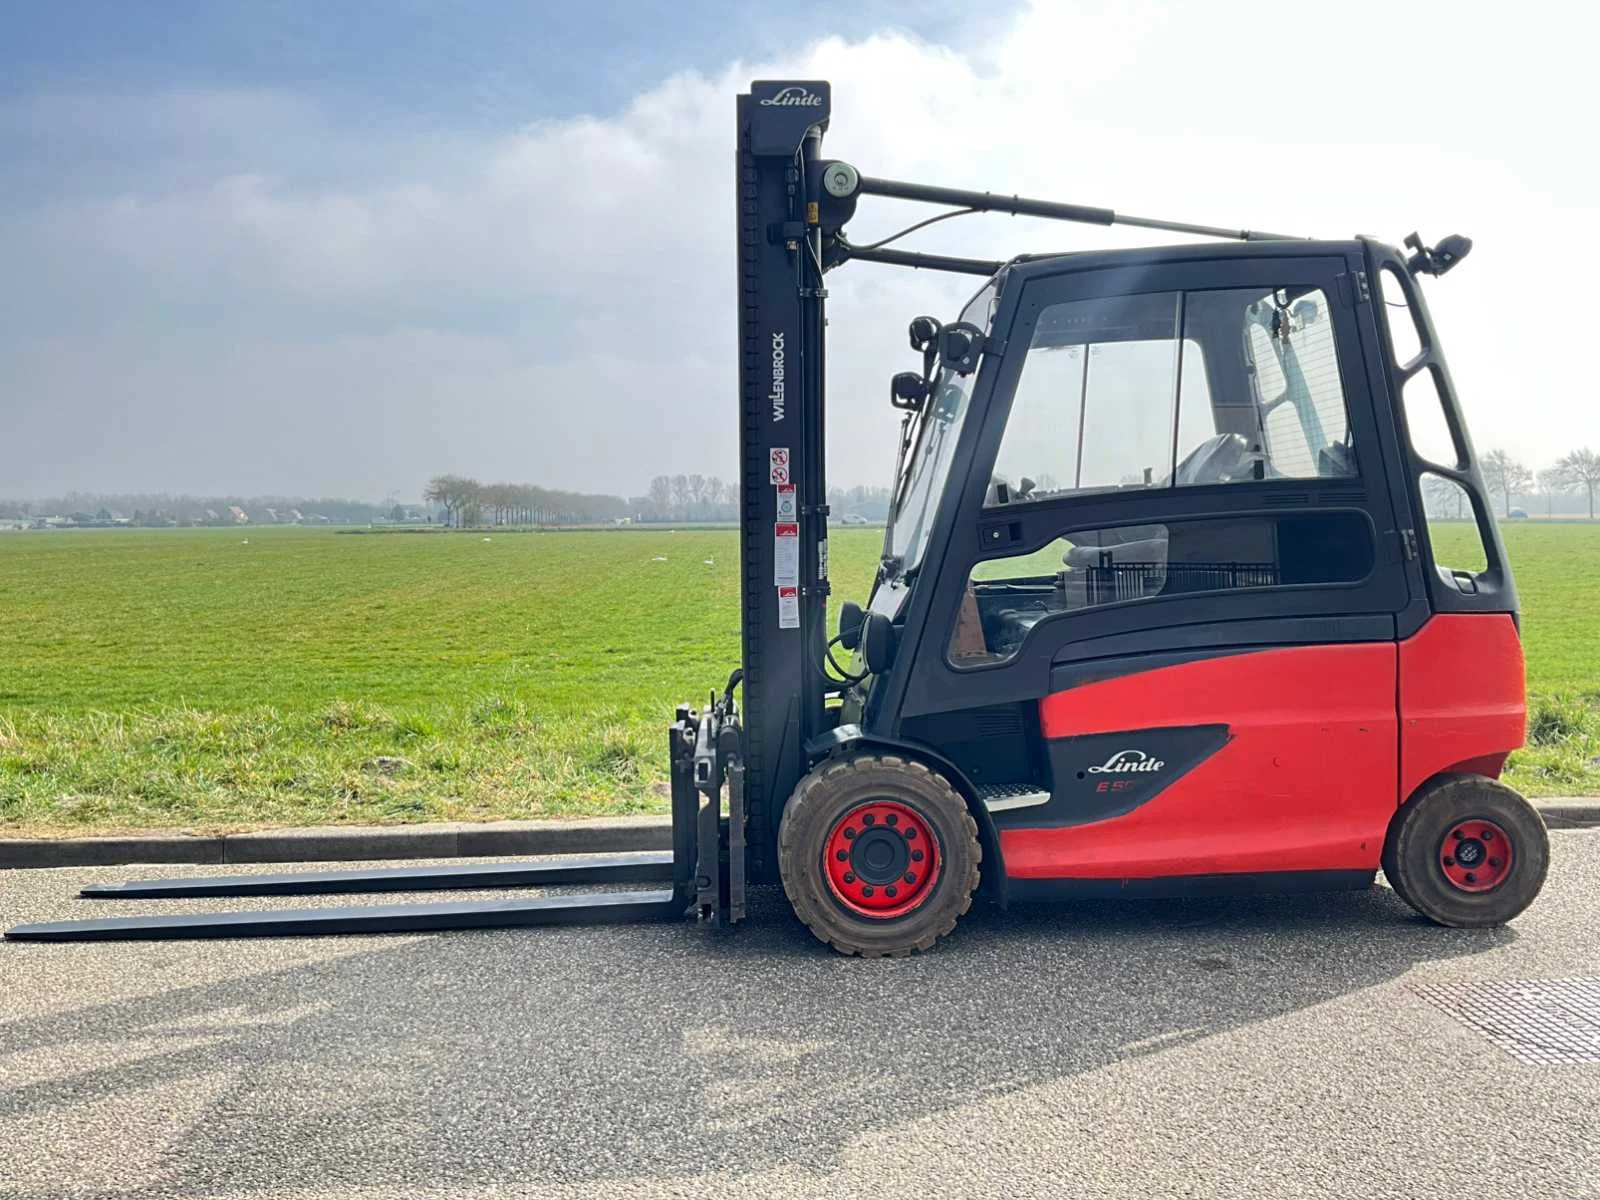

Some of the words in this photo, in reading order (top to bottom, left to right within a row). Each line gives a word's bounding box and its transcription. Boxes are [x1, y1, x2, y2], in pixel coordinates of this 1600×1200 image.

[760, 86, 822, 106] Linde
[768, 332, 784, 422] WILLENBROCK
[1088, 750, 1165, 773] Linde
